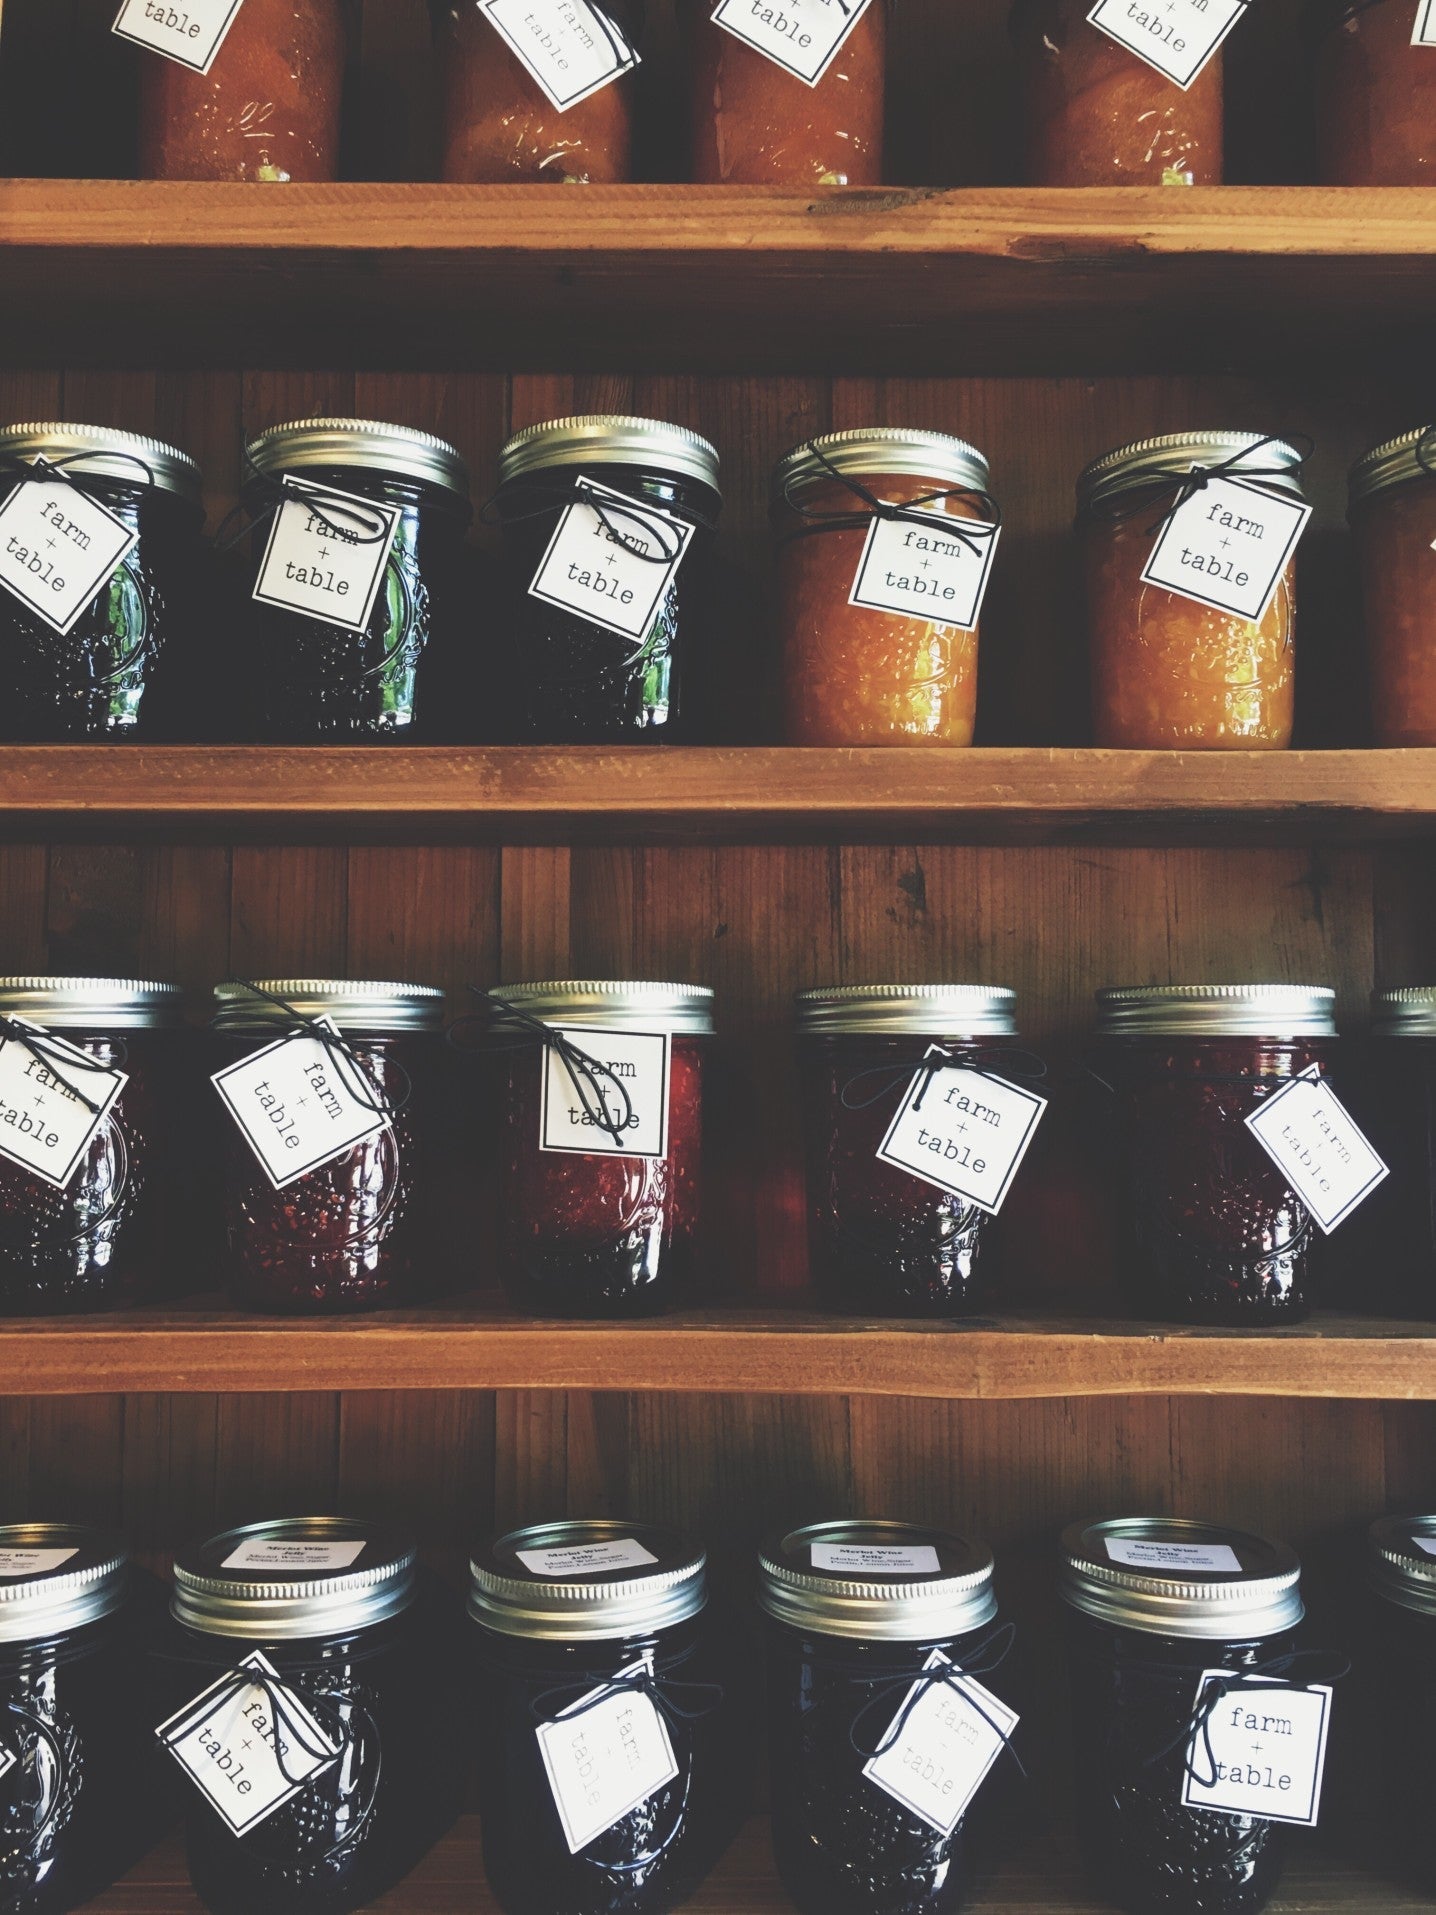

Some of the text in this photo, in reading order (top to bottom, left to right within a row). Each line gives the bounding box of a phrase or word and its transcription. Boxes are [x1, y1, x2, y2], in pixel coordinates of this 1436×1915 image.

[145, 1, 200, 38] table
[523, 11, 569, 71] table
[557, 2, 594, 49] farm
[750, 1, 812, 48] table
[1126, 2, 1186, 52] table
[40, 501, 92, 551] farm
[902, 531, 962, 558] farm
[1206, 503, 1265, 540] farm
[5, 536, 66, 592] table
[286, 561, 350, 596] table
[567, 562, 635, 604] table
[885, 570, 956, 601] table
[1180, 547, 1250, 587] table
[253, 1080, 301, 1149] table
[303, 1061, 345, 1121] farm
[943, 1087, 1001, 1128] farm
[917, 1127, 986, 1174] table
[1281, 1124, 1331, 1193] table
[1312, 1108, 1352, 1164] farm
[616, 1707, 642, 1773] farm
[934, 1700, 979, 1745] farm
[1230, 1707, 1292, 1735] farm
[198, 1727, 251, 1795] table
[572, 1731, 601, 1806] table
[901, 1745, 954, 1795] table
[1216, 1761, 1292, 1790] table
